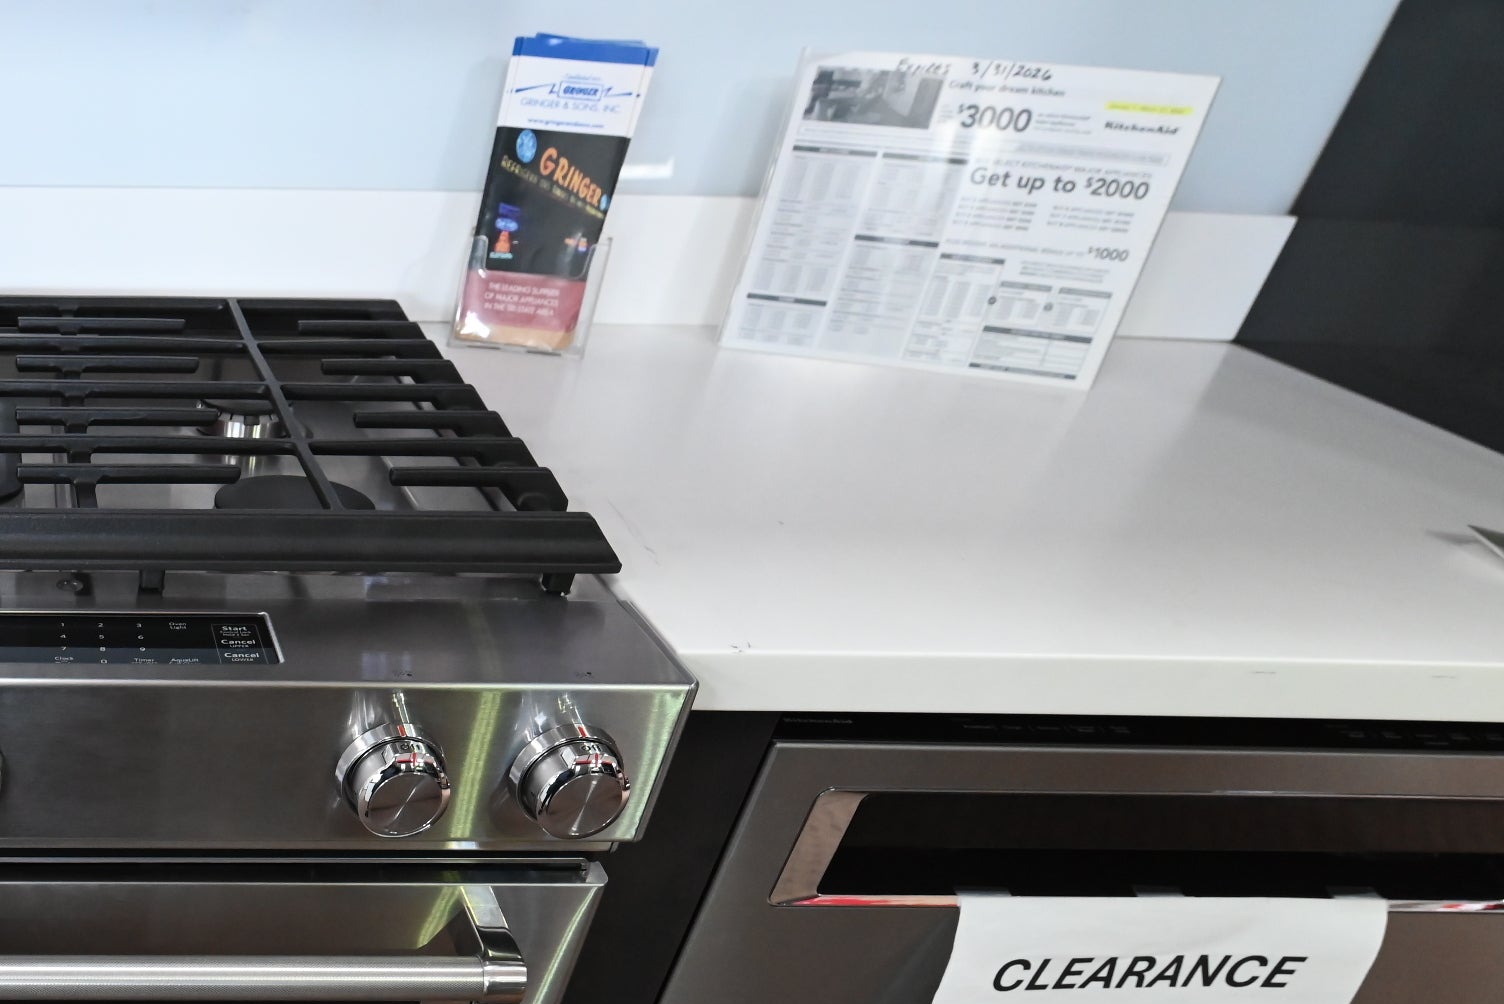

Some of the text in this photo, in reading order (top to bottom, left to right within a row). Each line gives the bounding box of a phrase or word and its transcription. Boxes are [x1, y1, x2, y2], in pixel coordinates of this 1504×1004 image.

[972, 61, 1053, 81] 3/31/2026
[958, 103, 1033, 133] $3000
[540, 147, 602, 207] GRINGER
[970, 166, 1150, 200] Get up to $2000
[1088, 246, 1129, 262] $1000
[992, 954, 1308, 992] CLEARANCE
